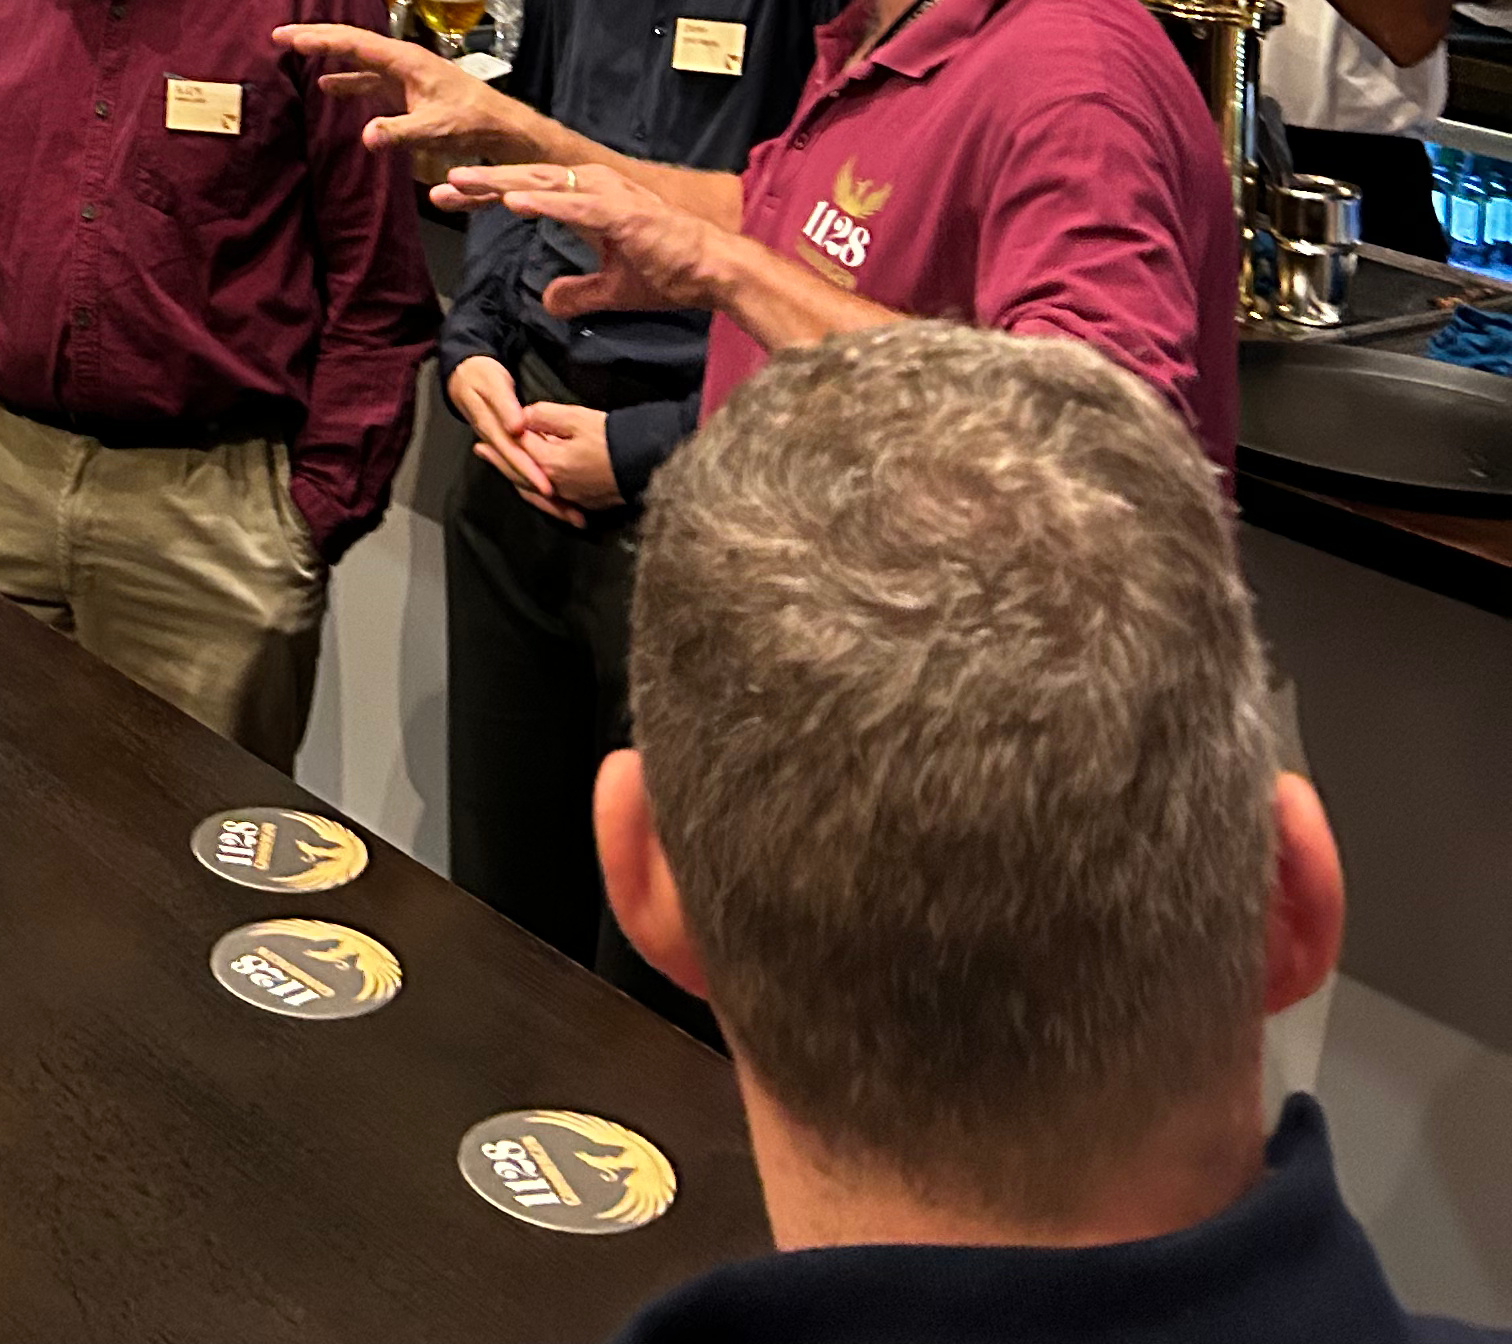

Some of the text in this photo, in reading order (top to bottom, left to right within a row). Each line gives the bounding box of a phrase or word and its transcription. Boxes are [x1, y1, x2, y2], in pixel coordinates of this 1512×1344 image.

[802, 200, 871, 267] 1128
[215, 820, 259, 866] 1128
[230, 954, 322, 1007] 1128
[480, 1139, 562, 1208] 1128
